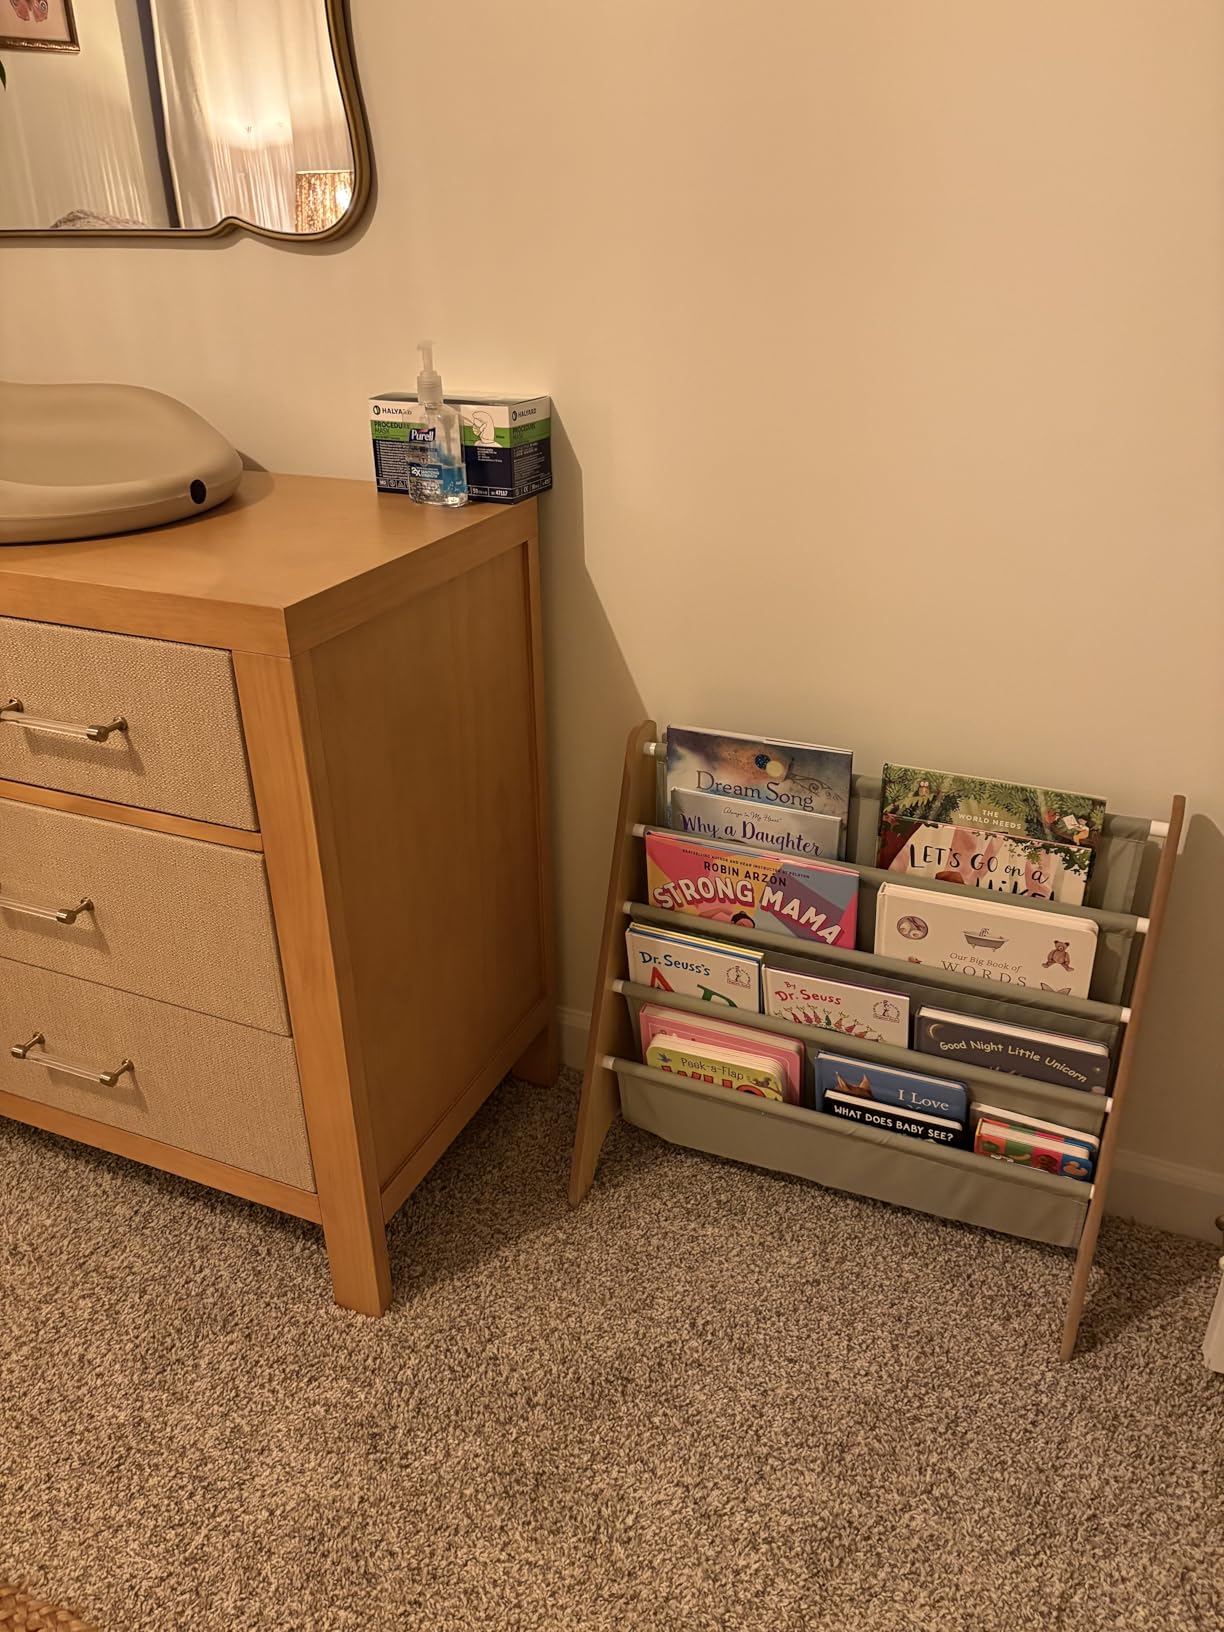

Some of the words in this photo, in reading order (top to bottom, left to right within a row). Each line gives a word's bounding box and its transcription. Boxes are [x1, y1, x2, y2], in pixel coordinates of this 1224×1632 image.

[411, 429, 434, 441] Purell
[696, 770, 761, 799] Dream
[766, 781, 814, 813] Song
[958, 814, 990, 824] WORLD
[992, 819, 1022, 830] NEEDS
[982, 809, 999, 818] THE
[680, 813, 719, 838] Why
[724, 825, 737, 837] a
[742, 820, 824, 857] Daughter
[703, 861, 740, 877] ROBIN
[744, 870, 786, 887] ARZÓN
[909, 843, 961, 869] LET'S
[970, 853, 998, 872] GO
[1004, 865, 1025, 877] on
[1031, 870, 1049, 884] a
[652, 876, 754, 910] STRONG
[760, 886, 843, 945] MAMA
[639, 951, 662, 965] Dr.
[663, 954, 711, 976] Seuss's
[941, 960, 1027, 987] WORDS
[949, 952, 968, 961] Our
[969, 956, 984, 966] Big
[986, 959, 1009, 970] Book
[1011, 965, 1023, 974] of
[774, 990, 799, 1002] Dr.
[800, 988, 842, 1005] Seuss
[784, 981, 796, 990] By
[681, 1057, 744, 1081] Peek-a-Flap
[939, 1040, 967, 1051] Good
[970, 1040, 1004, 1053] Night
[1008, 1045, 1041, 1062] Little
[1044, 1056, 1088, 1083] Unicorn
[898, 1089, 905, 1101] I
[911, 1092, 950, 1111] Love
[833, 1104, 862, 1119] WHAT
[865, 1113, 893, 1127] DOES
[895, 1120, 925, 1135] BABY
[927, 1129, 954, 1142] SEE?
